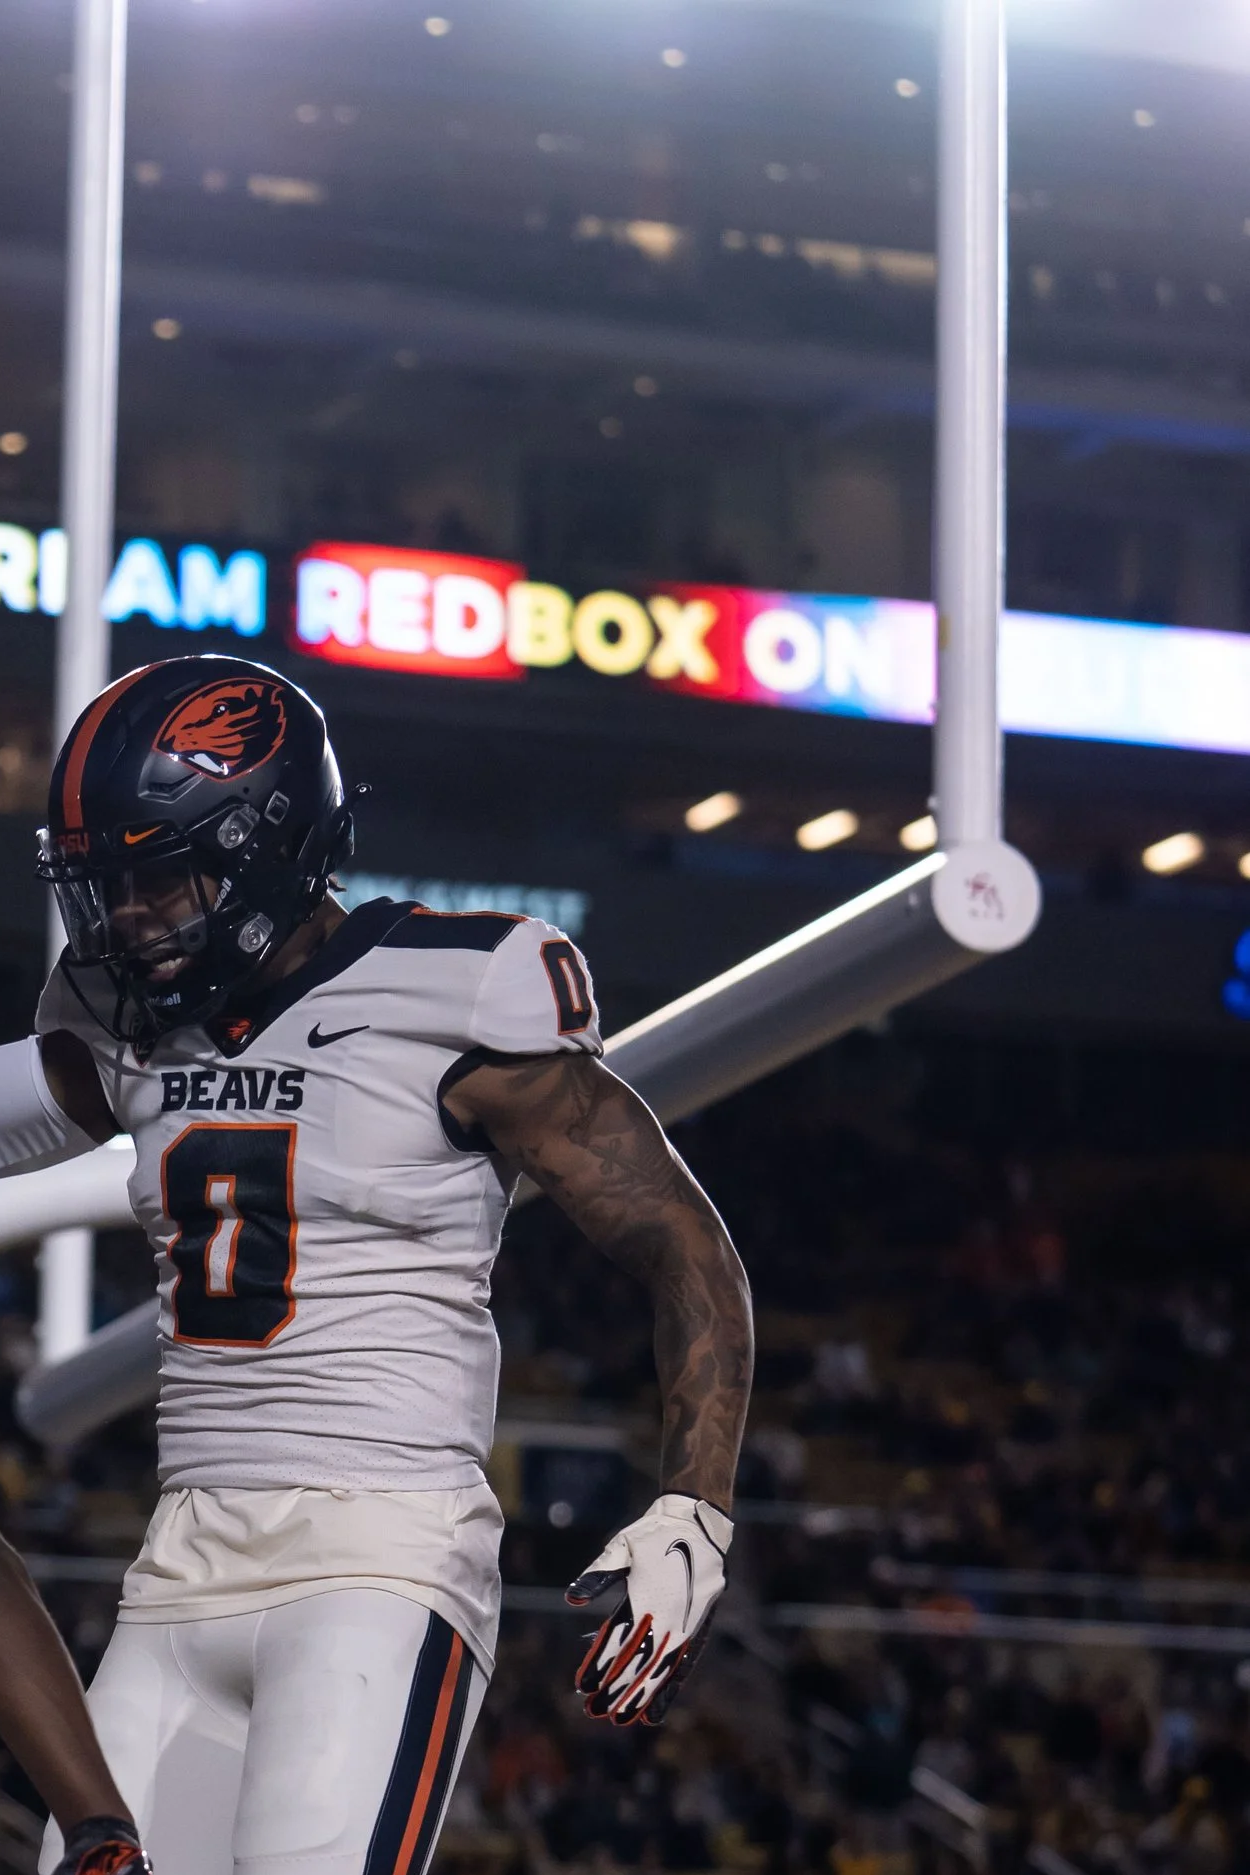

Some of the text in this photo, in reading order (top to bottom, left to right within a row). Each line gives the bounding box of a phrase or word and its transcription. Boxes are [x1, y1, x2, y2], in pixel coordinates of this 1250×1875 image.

[297, 557, 720, 685] REDBOX
[744, 608, 889, 700] ON
[540, 939, 590, 1036] 0
[161, 1069, 306, 1112] BEAVS
[161, 1122, 300, 1348] 0
